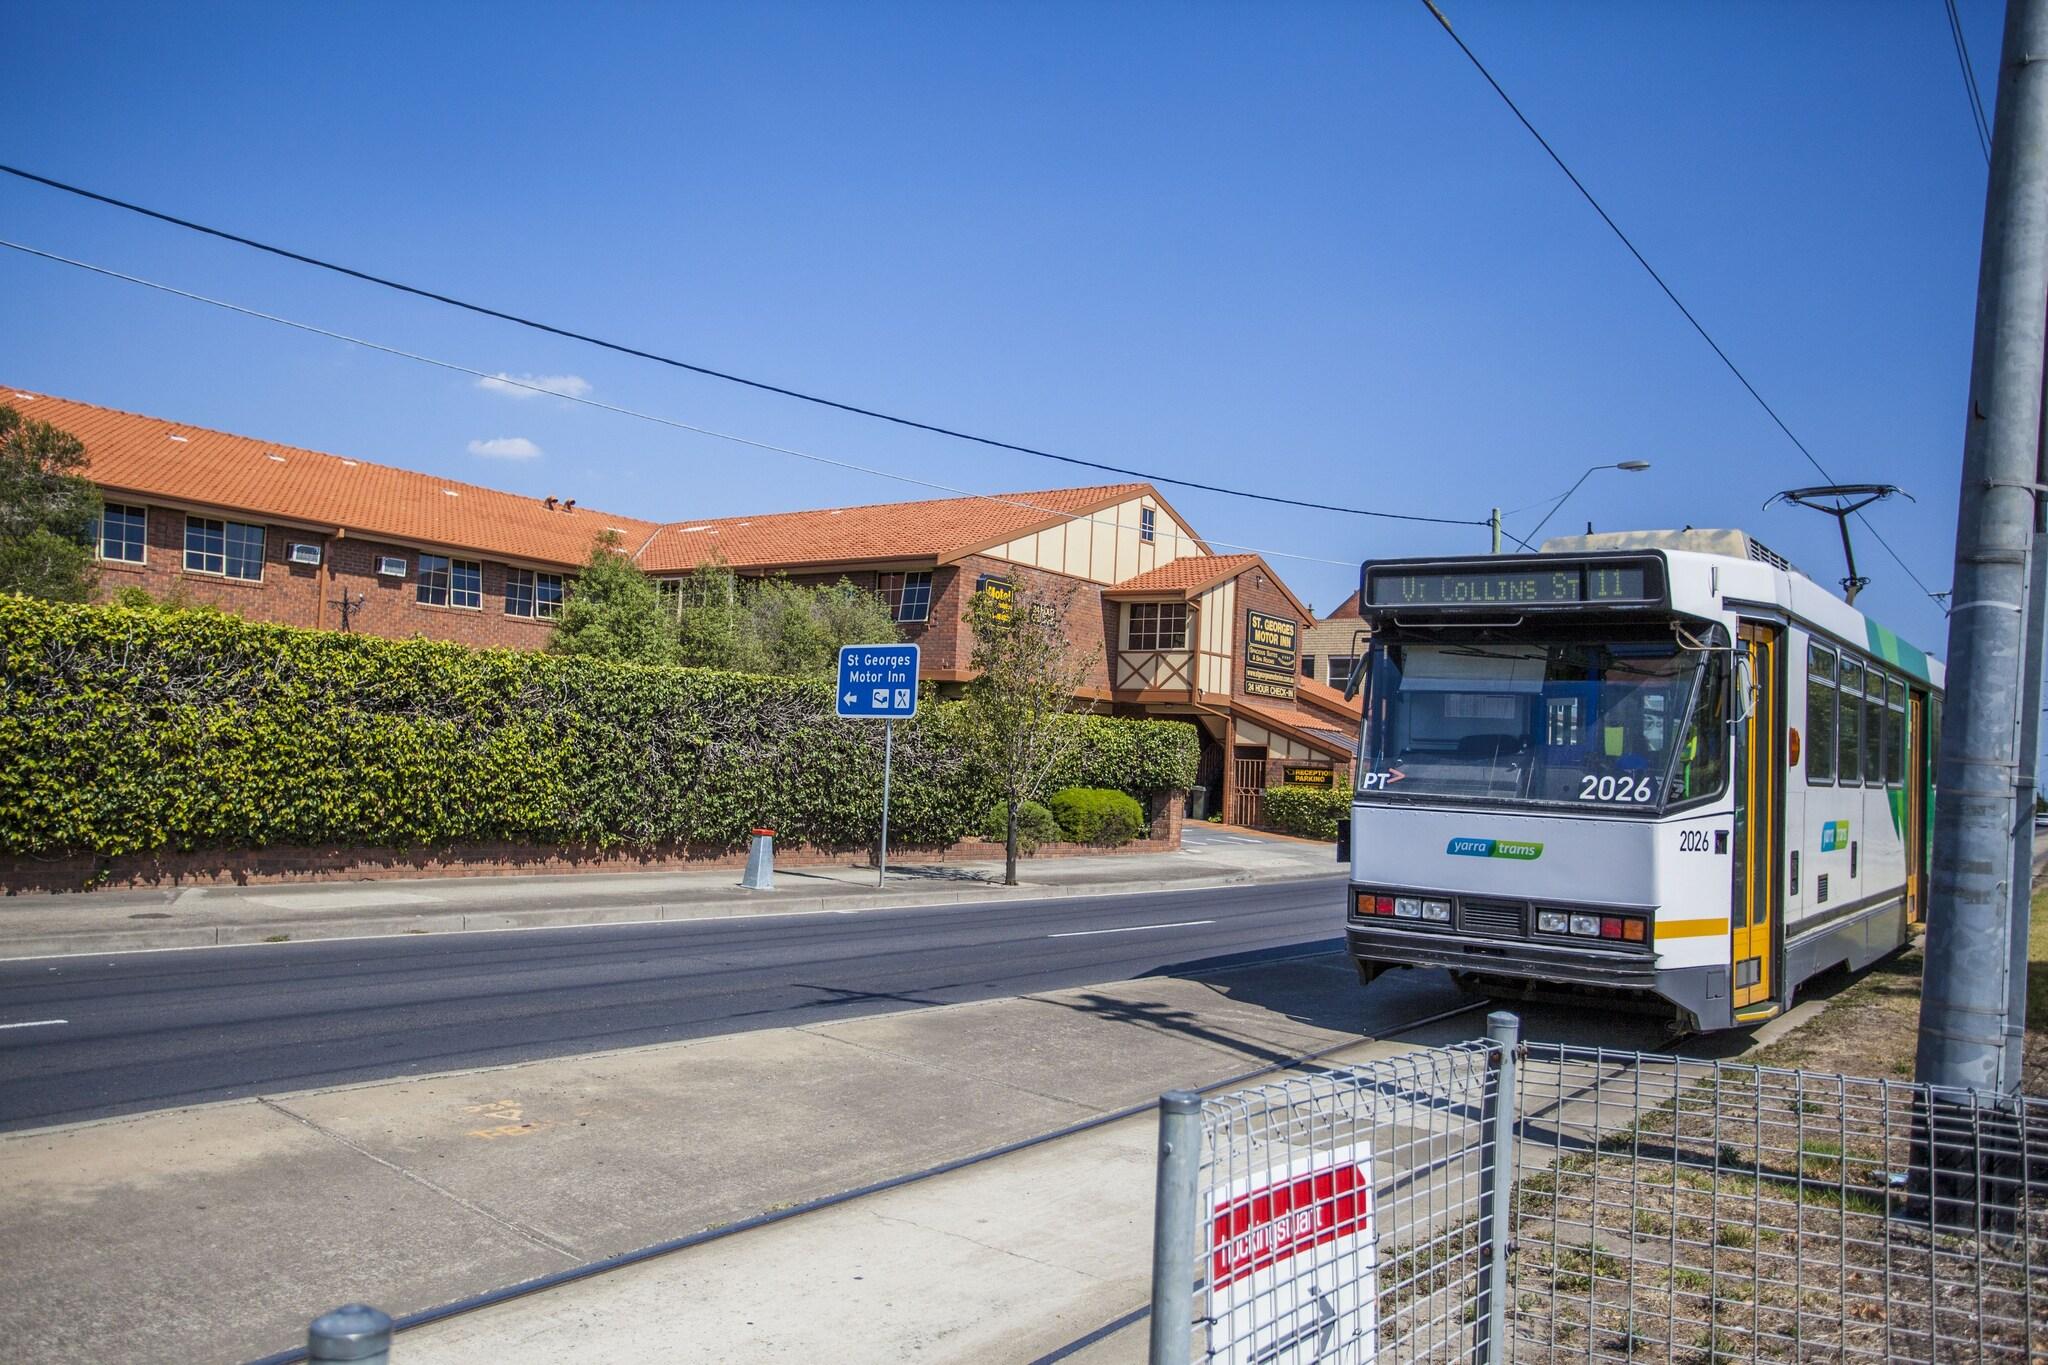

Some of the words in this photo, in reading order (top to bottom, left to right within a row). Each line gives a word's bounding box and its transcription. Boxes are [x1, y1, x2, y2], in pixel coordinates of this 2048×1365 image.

[1599, 569, 1623, 596] 11
[1252, 615, 1263, 629] ST.
[1264, 619, 1294, 636] GEORGES
[1254, 630, 1279, 645] MOTOR
[1279, 635, 1291, 648] INN
[847, 654, 859, 666] St
[864, 654, 911, 669] Georges
[849, 671, 883, 683] Motor
[888, 670, 906, 683] Inn
[1247, 683, 1254, 692] 24
[1255, 684, 1269, 693] HOUR
[1270, 687, 1294, 697] CHECK-IN
[1579, 775, 1651, 801] 2026
[1454, 841, 1487, 853] yarra
[1499, 843, 1536, 856] trams
[1680, 831, 1709, 852] 2026
